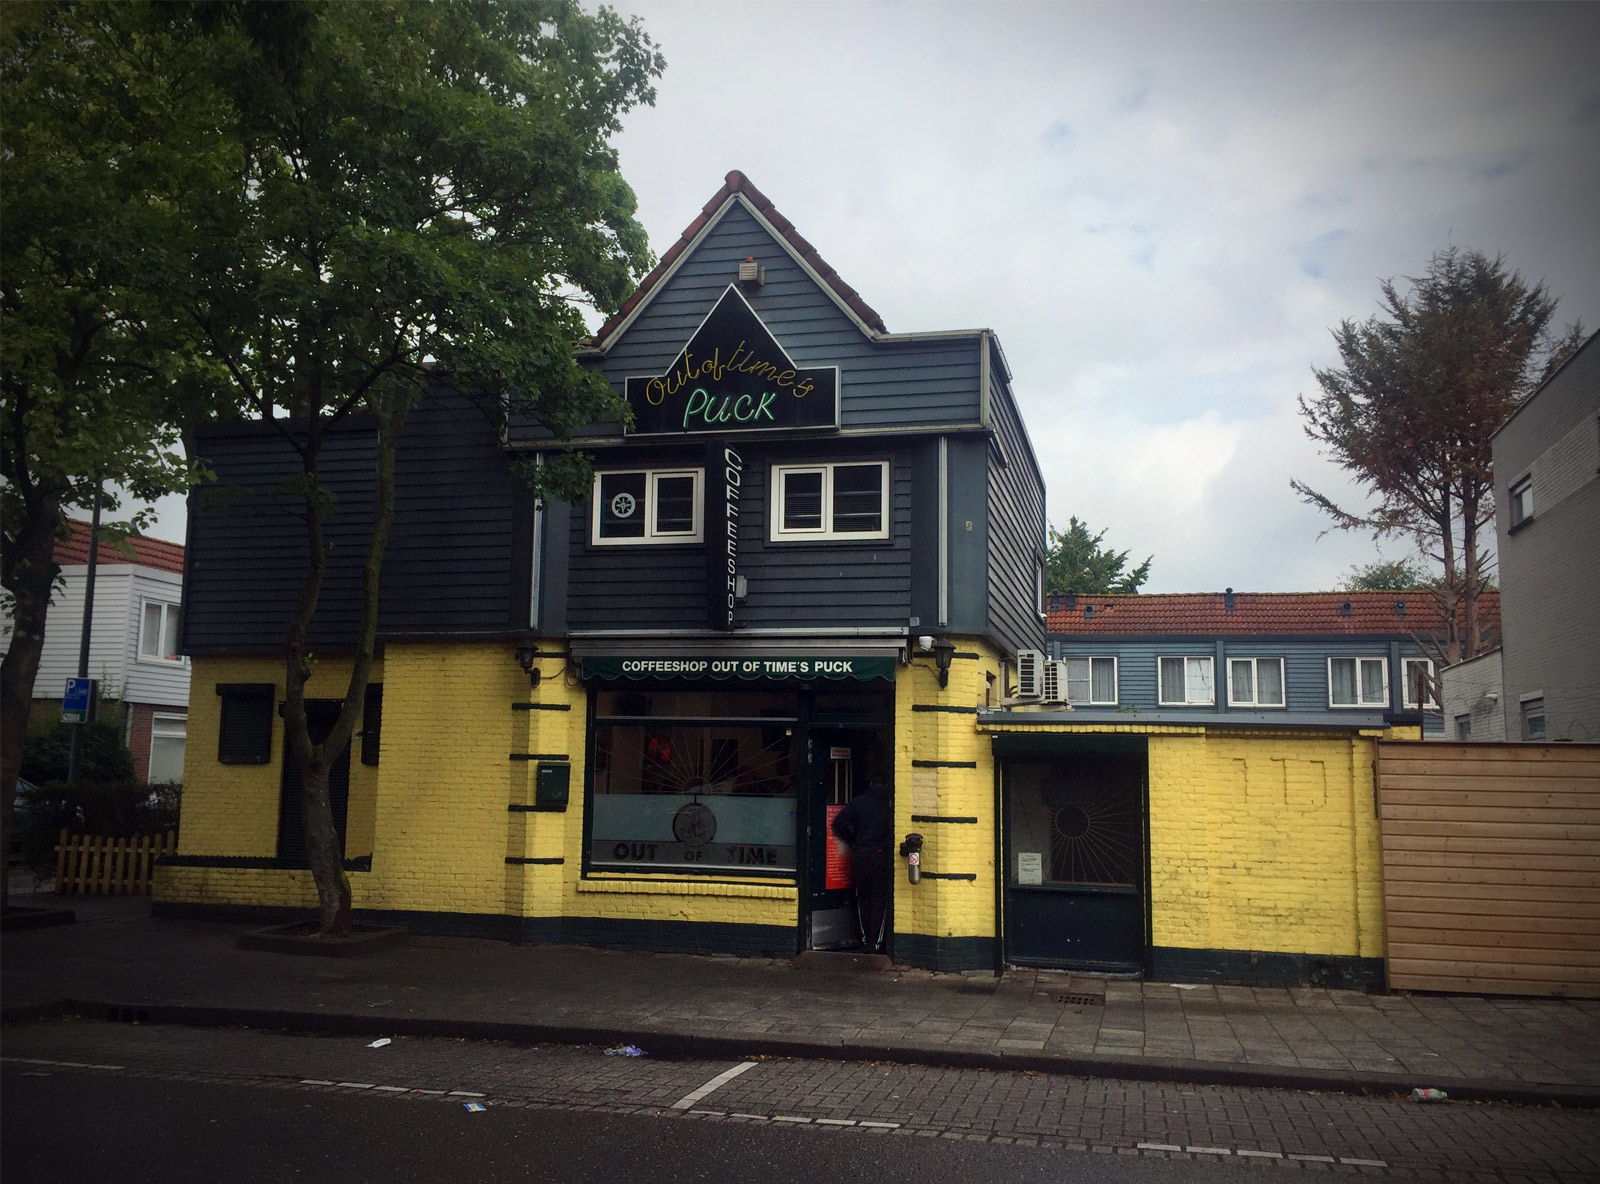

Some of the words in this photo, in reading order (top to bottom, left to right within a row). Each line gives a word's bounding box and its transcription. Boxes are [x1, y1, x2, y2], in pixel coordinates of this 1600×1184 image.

[645, 350, 700, 406] Out
[702, 348, 725, 381] of
[724, 448, 743, 625] COFFEESHOP
[622, 660, 708, 672] COFFEESHOP
[711, 660, 739, 673] OUT
[742, 661, 761, 673] OF
[764, 661, 809, 673] TIME'S
[814, 661, 853, 673] PUCK
[67, 679, 76, 693] P
[613, 842, 658, 861] OUT
[684, 850, 703, 861] OF
[727, 845, 777, 865] TIME
